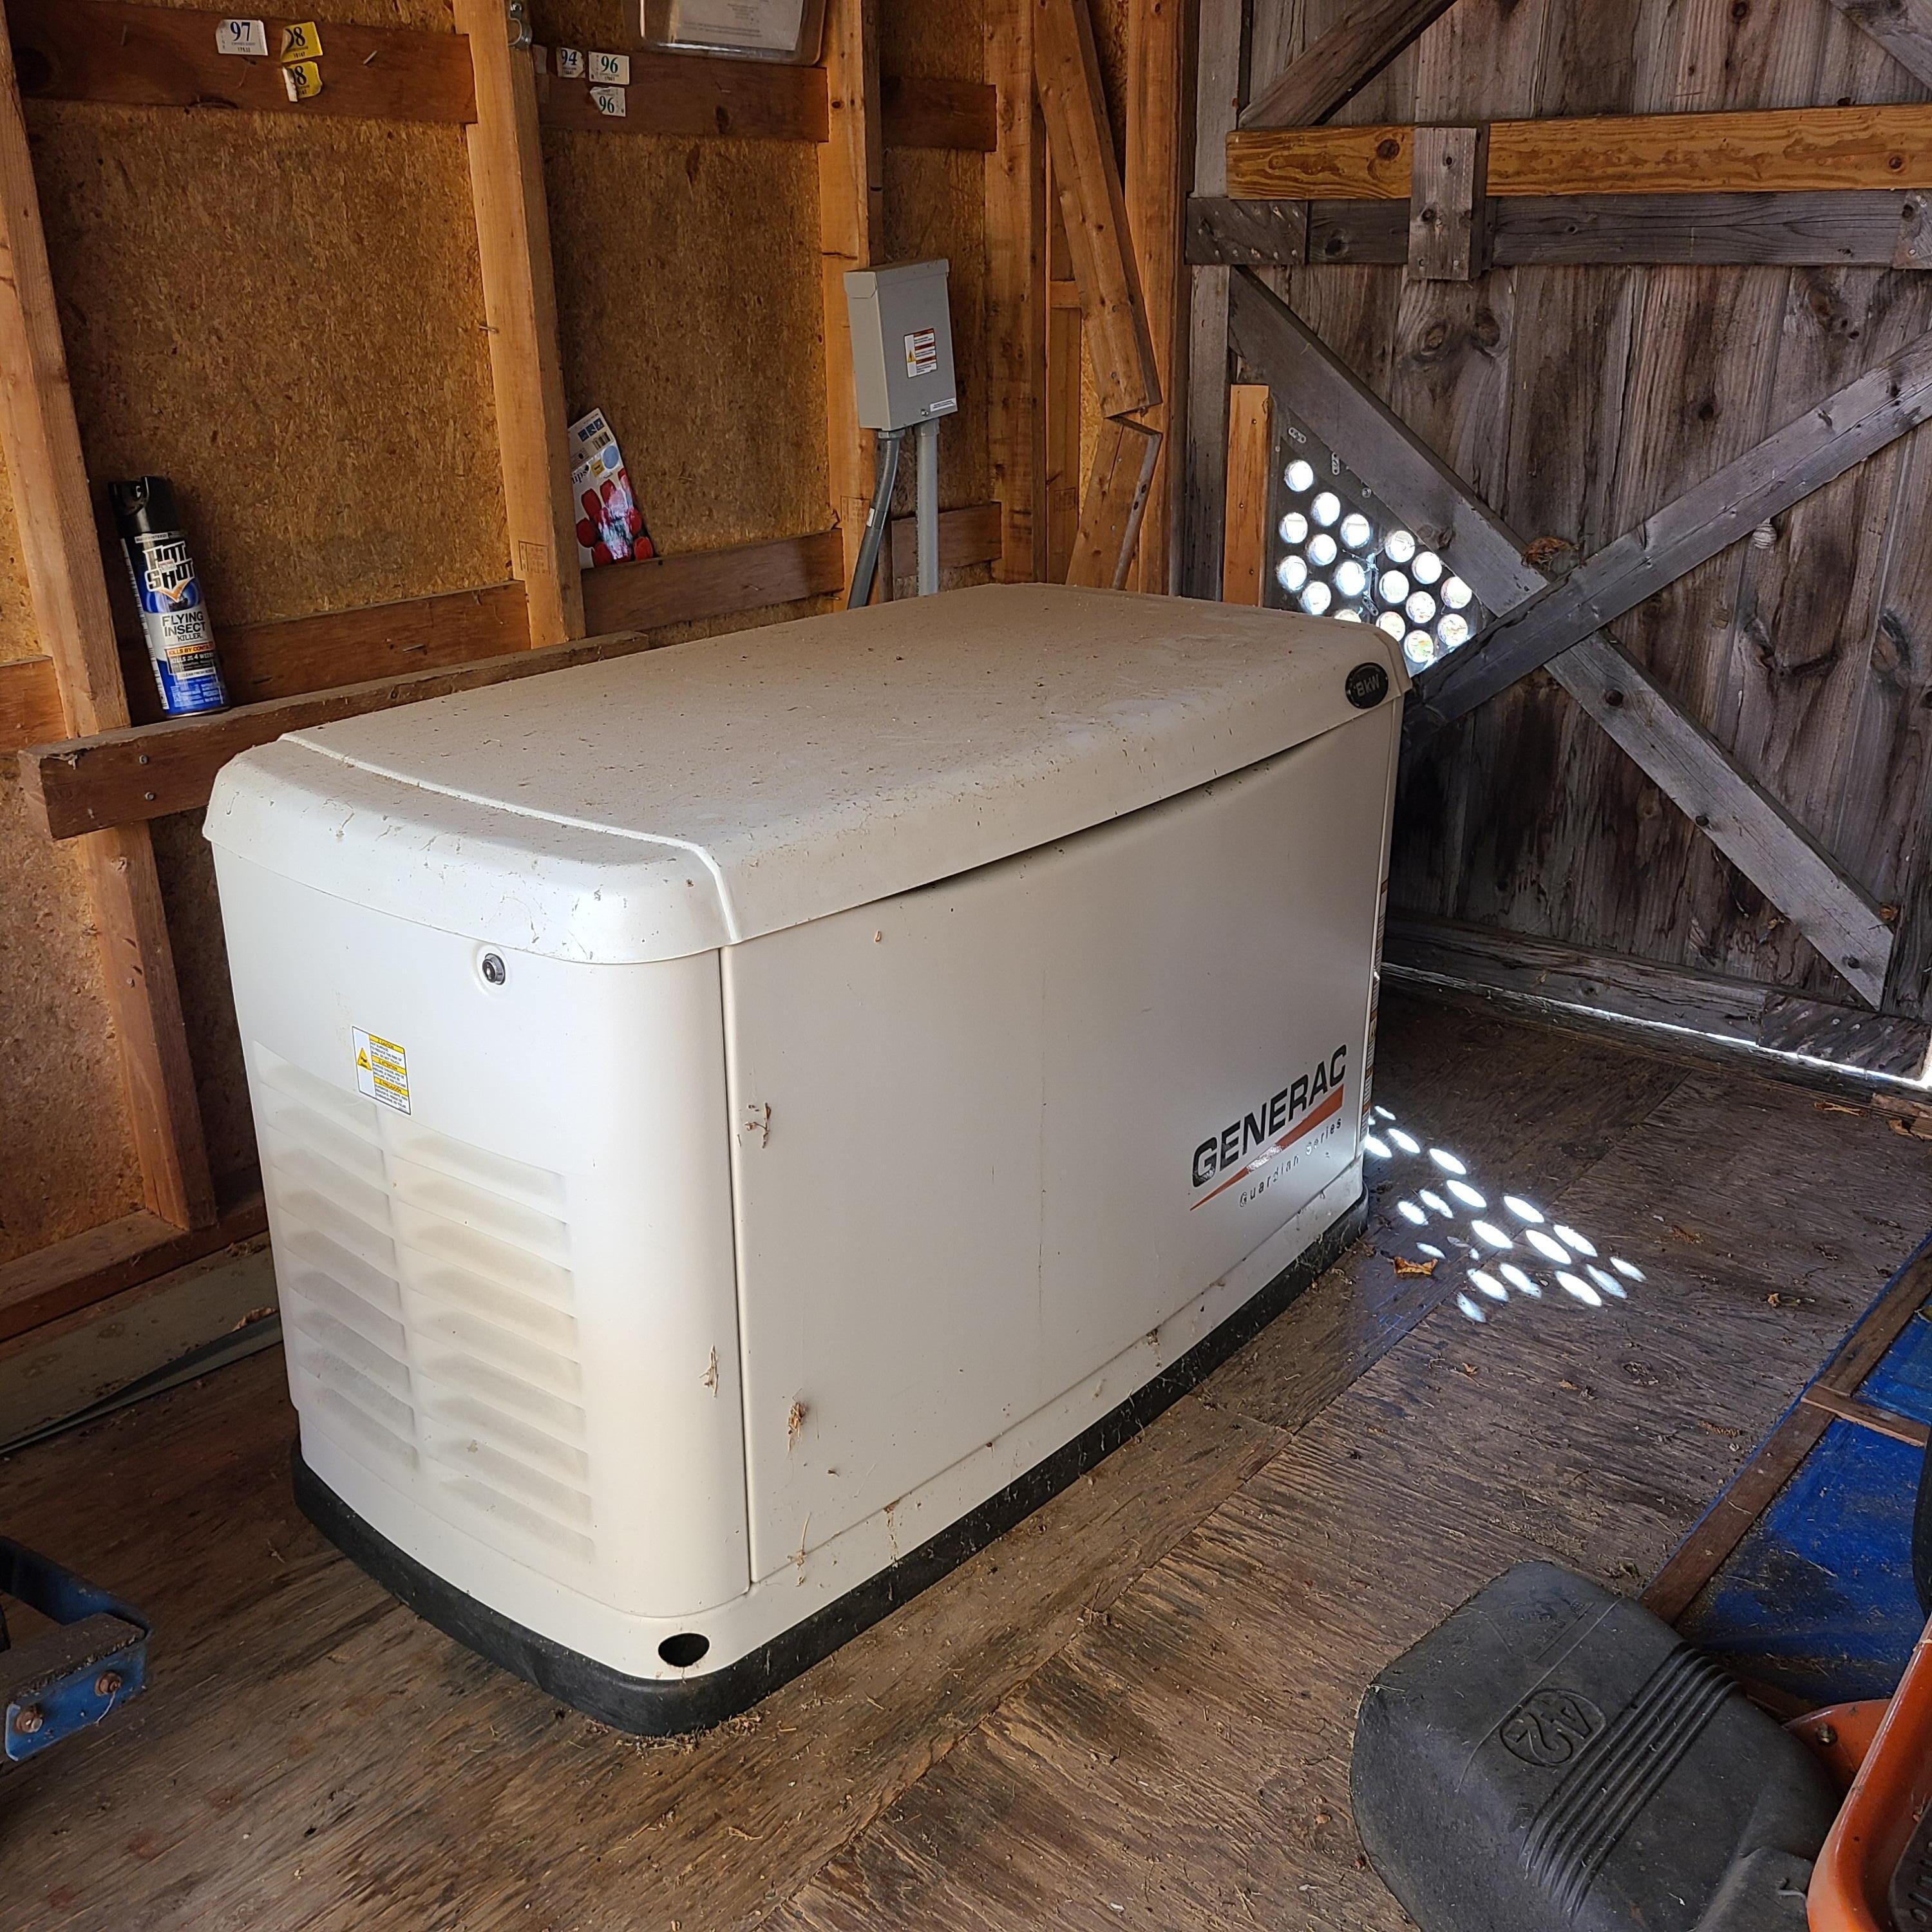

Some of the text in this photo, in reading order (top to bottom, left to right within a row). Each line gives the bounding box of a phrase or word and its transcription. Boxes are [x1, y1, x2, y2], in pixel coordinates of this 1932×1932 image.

[230, 21, 251, 42] 97
[561, 49, 577, 66] 94
[601, 55, 618, 73] 96
[599, 95, 615, 114] 96
[142, 540, 185, 571] HOT
[162, 611, 204, 627] FLYING
[164, 621, 206, 637] INSECT
[178, 632, 202, 642] KILLER
[1193, 1044, 1347, 1188] GENERAC
[1240, 1118, 1341, 1208] Guardian Series
